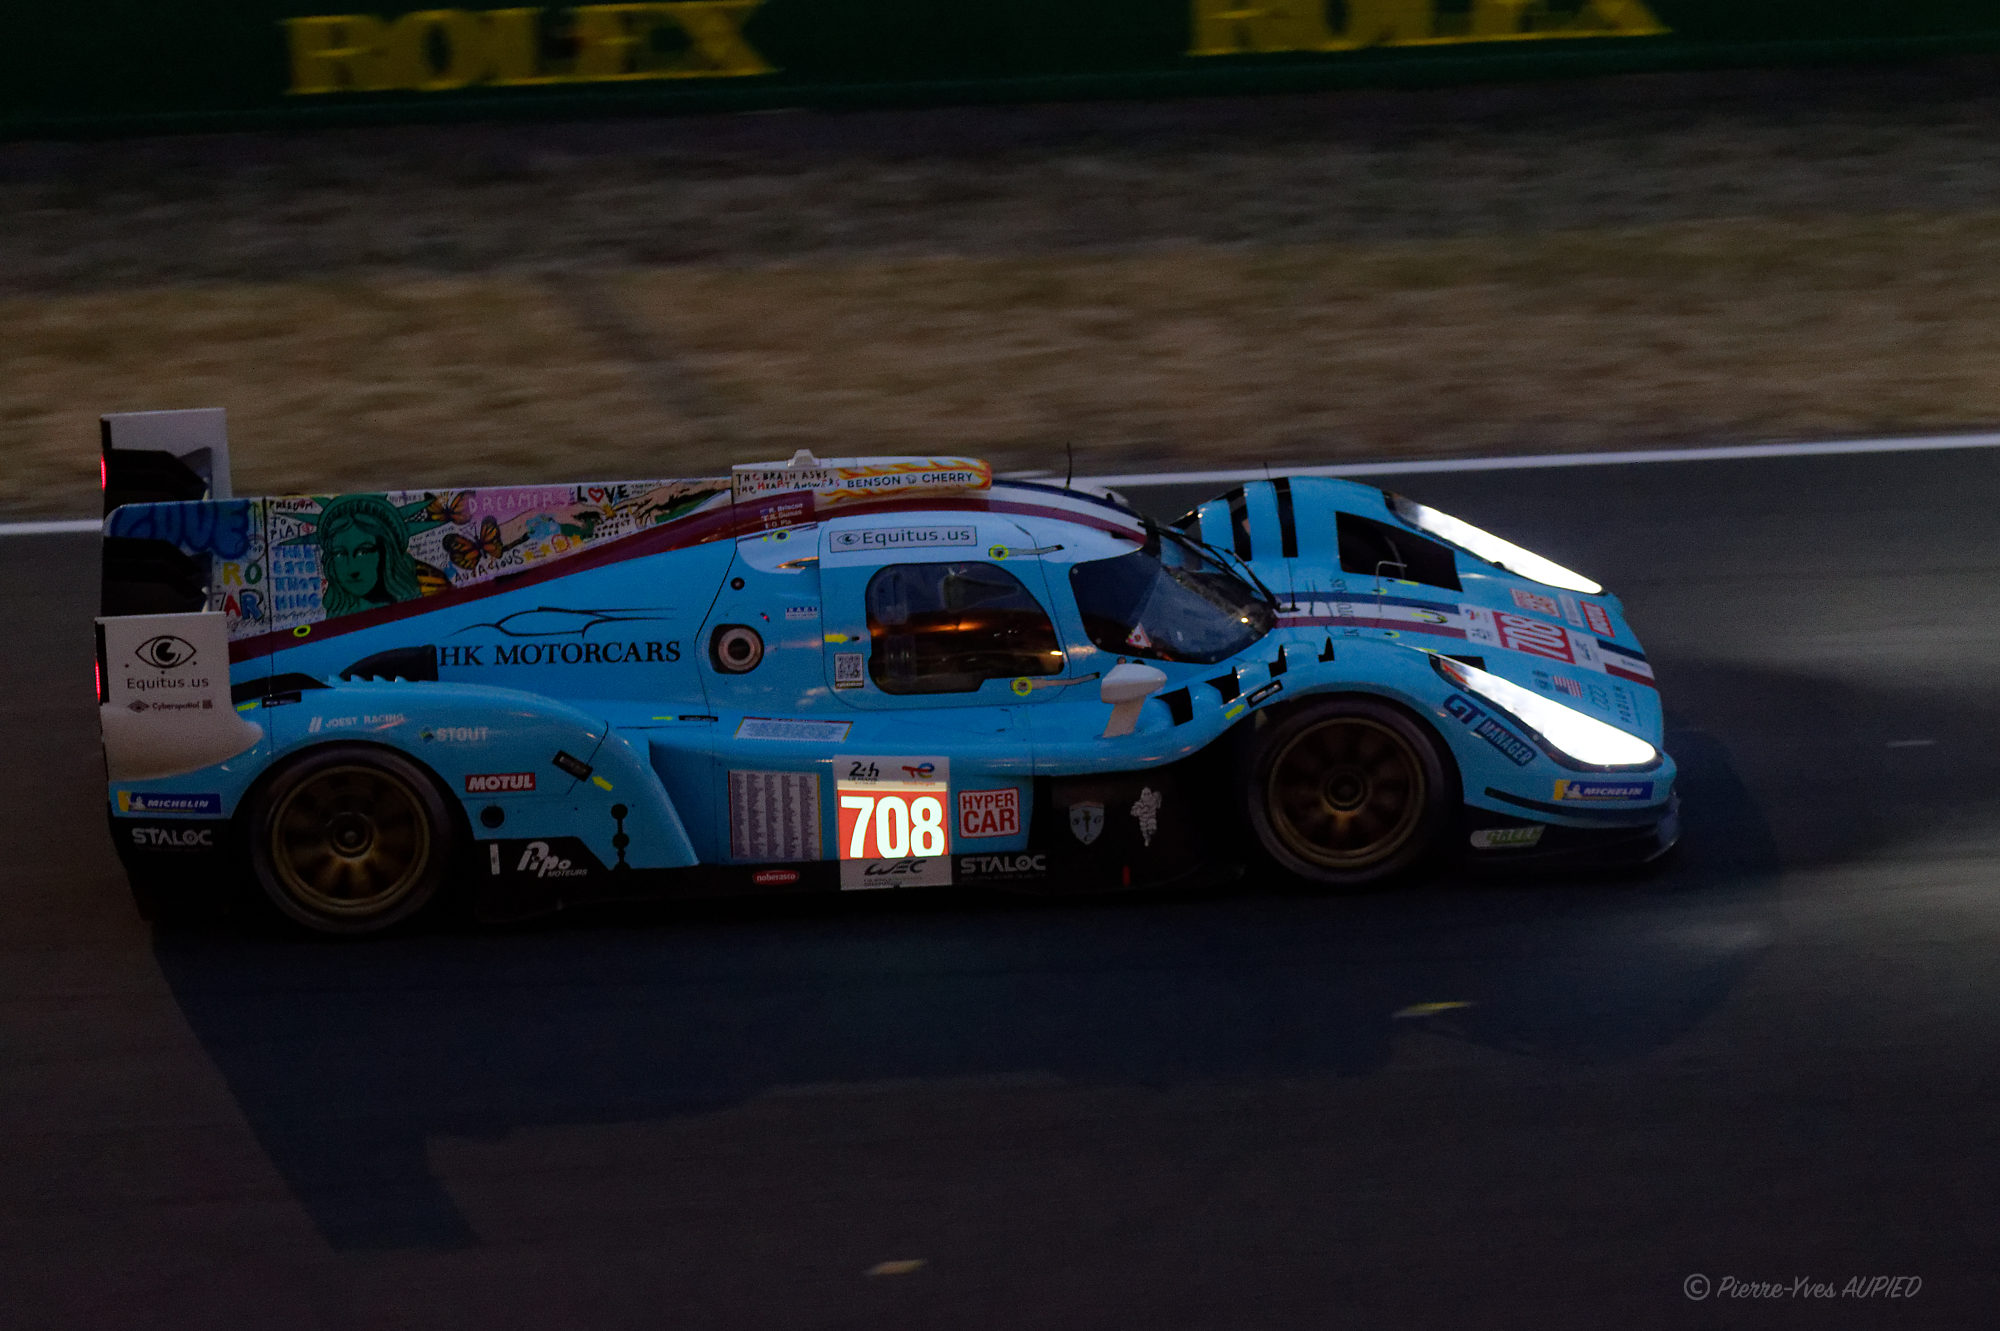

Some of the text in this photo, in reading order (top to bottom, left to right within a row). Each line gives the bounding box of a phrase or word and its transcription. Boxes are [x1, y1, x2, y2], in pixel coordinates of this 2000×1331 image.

[281, 2, 782, 95] ROLEX
[847, 475, 901, 488] BENSON
[921, 472, 974, 483] CHERRY
[269, 500, 314, 512] FREEDOM
[270, 516, 287, 527] TO
[270, 523, 302, 540] PLAY
[862, 527, 971, 547] Equitus.us
[439, 640, 681, 667] HK MOTORCARS
[126, 676, 209, 692] Equitus.us
[363, 713, 405, 724] RACING
[436, 727, 489, 742] STOUT
[1443, 693, 1534, 764] GT MANAGER
[467, 774, 534, 791] MOTUL
[1583, 786, 1644, 797] MICHELIN
[147, 799, 209, 809] MICHELIN
[962, 793, 1015, 810] HYPER
[840, 796, 946, 859] 708
[963, 809, 1016, 834] CAR
[131, 827, 214, 846] STALOC
[864, 859, 927, 876] WEC
[959, 853, 1047, 874] STALOC
[547, 868, 589, 878] MOTEURS
